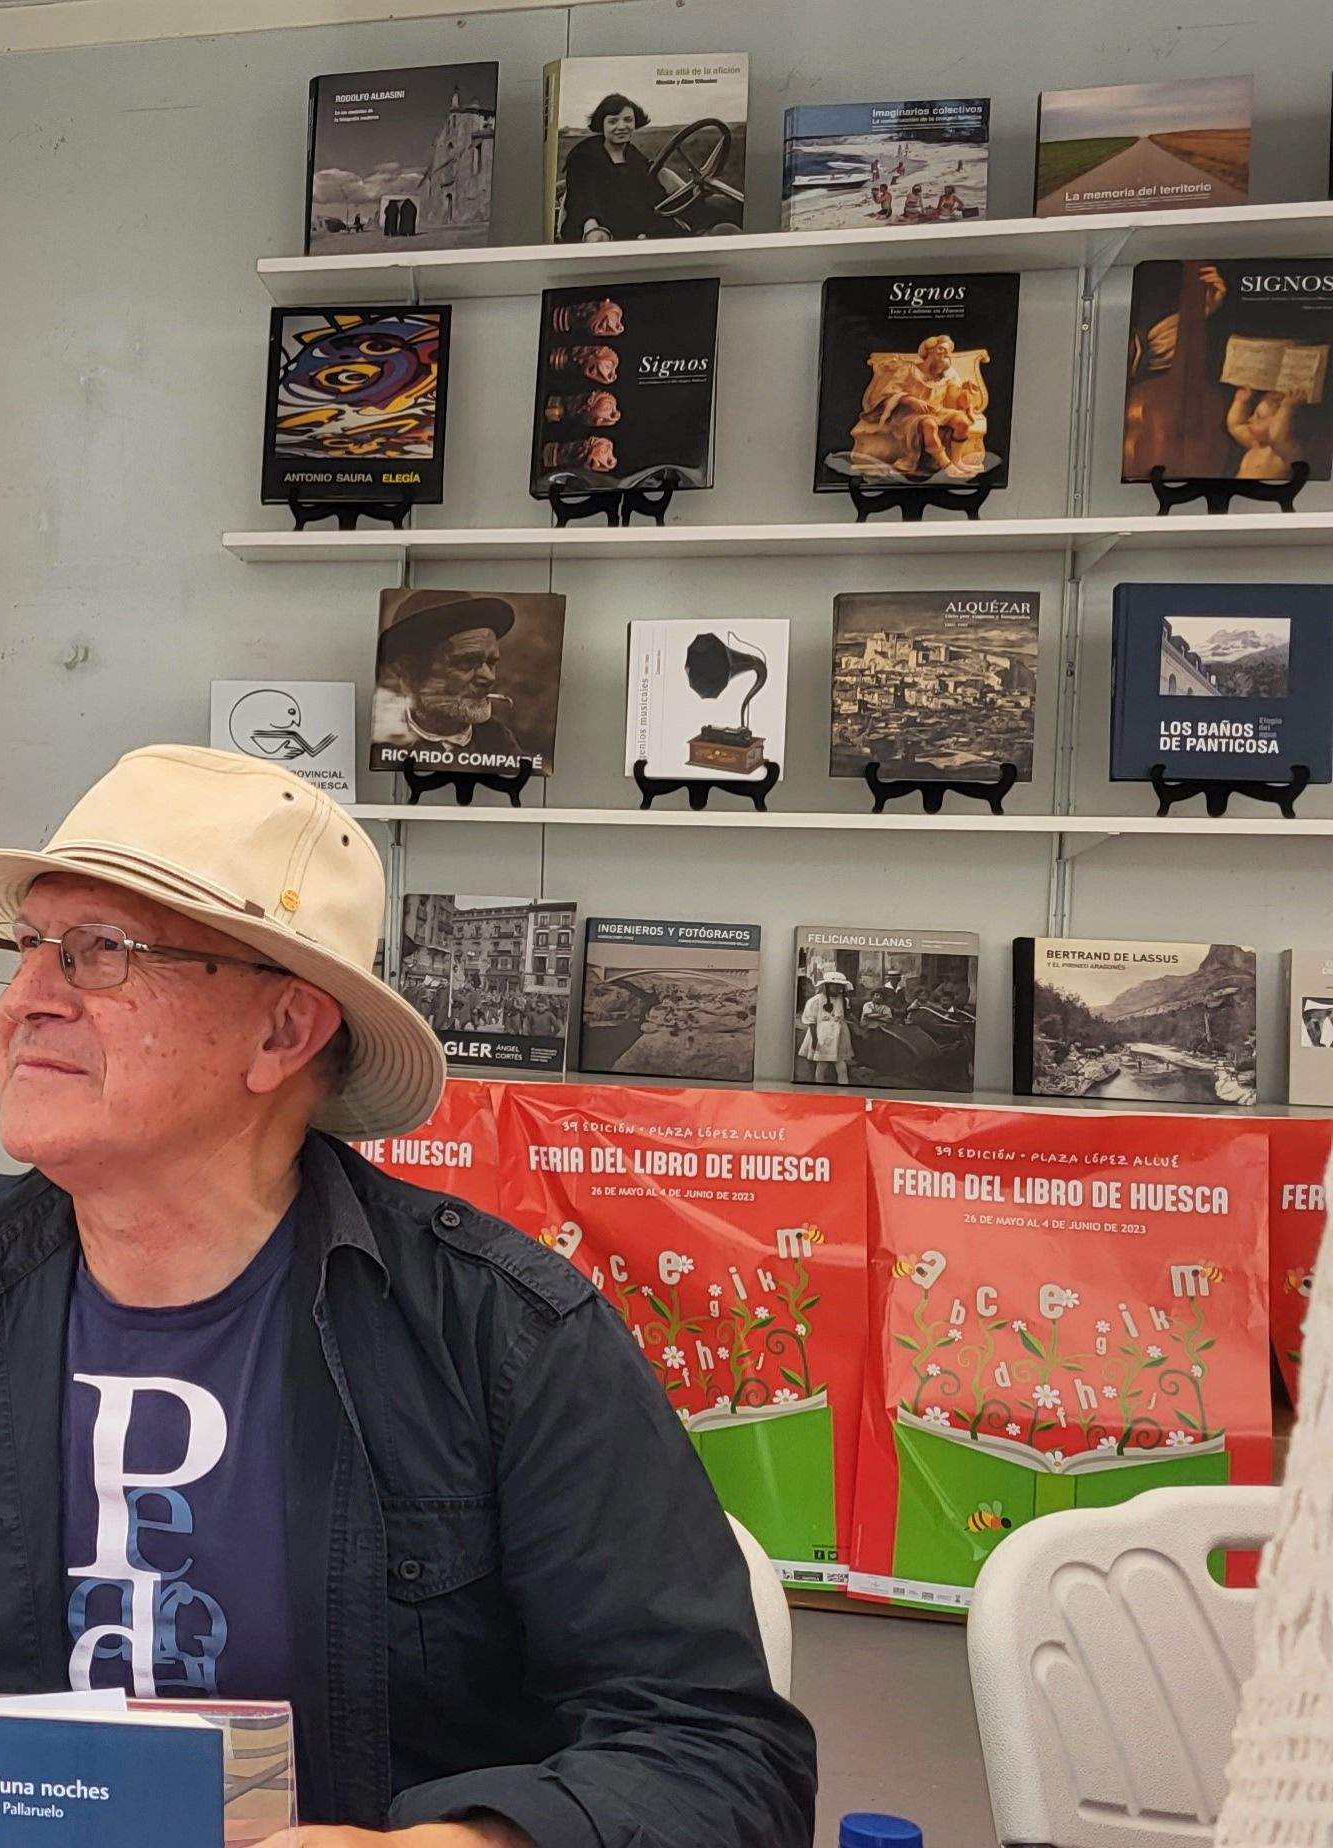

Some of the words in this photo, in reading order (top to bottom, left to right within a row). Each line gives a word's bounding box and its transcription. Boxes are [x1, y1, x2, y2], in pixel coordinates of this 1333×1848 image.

[335, 92, 369, 102] RODOLFO
[873, 107, 930, 119] Imaginarios
[933, 106, 983, 116] colectivos
[1066, 192, 1080, 201] La
[1083, 188, 1134, 200] memoria
[1138, 185, 1157, 197] del
[1160, 182, 1212, 194] territorio
[1241, 275, 1333, 293] SIGNOS
[889, 282, 966, 307] Signos
[639, 355, 709, 378] Signos
[284, 472, 333, 483] ANTONIO
[336, 472, 373, 483] SAURA
[382, 471, 421, 484] ELEGÍA
[945, 600, 1030, 614] ALQUÉZAR
[640, 678, 649, 726] musicales
[1160, 721, 1192, 736] LOS
[1198, 720, 1254, 738] BAÑOS
[1159, 737, 1181, 751] DE
[1186, 738, 1279, 754] PANTICOSA
[381, 749, 454, 764] RICARDO
[458, 752, 542, 769] COMPAIÉ
[598, 923, 664, 936] INGENIEROS
[668, 927, 676, 937] Y
[679, 926, 750, 940] FOTÓGRAFOS
[808, 933, 866, 946] FELICIANO
[869, 937, 913, 948] LLANAS
[1046, 950, 1111, 961] BERTRAND
[1114, 952, 1130, 962] DE
[1133, 953, 1179, 964] LASSUS
[443, 1040, 492, 1058] GLER
[495, 1052, 523, 1061] CORTÉS
[562, 1120, 579, 1132] 39
[582, 1121, 635, 1134] EDICIÓN
[649, 1125, 693, 1138] PLAZA
[698, 1126, 739, 1139] LÓPEZ
[743, 1128, 786, 1141] ALLUÉ
[360, 1138, 385, 1164] DE
[391, 1138, 472, 1168] HUESCA
[935, 1146, 952, 1157] 39
[958, 1148, 1015, 1161] EDICIÓN
[1031, 1152, 1078, 1164] PLAZA
[1085, 1153, 1128, 1165] LÓPEZ
[1133, 1154, 1180, 1168] ALLUÉ
[529, 1145, 584, 1173] FERIA
[591, 1147, 627, 1174] DEL
[634, 1149, 698, 1177] LIBRO
[706, 1153, 733, 1179] DE
[740, 1154, 830, 1182] HUESCA
[591, 1186, 602, 1196] 26
[605, 1186, 616, 1196] DE
[619, 1187, 644, 1197] MAYO
[646, 1188, 658, 1197] AL
[669, 1189, 681, 1198] DE
[684, 1189, 713, 1199] JUNIO
[716, 1191, 729, 1200] DE
[732, 1192, 755, 1202] 2023
[893, 1167, 956, 1199] FERIA
[964, 1174, 1005, 1202] DEL
[1013, 1176, 1083, 1207] LIBRO
[1092, 1181, 1122, 1210] DE
[1131, 1183, 1229, 1215] HUESCA
[964, 1213, 976, 1223] 26
[980, 1215, 993, 1225] DE
[996, 1217, 1024, 1226] MAYO
[1027, 1218, 1039, 1227] AL
[1051, 1220, 1065, 1230] DE
[1068, 1221, 1100, 1231] JUNIO
[1104, 1223, 1118, 1233] DE
[1121, 1224, 1146, 1234] 2023
[41, 1779, 110, 1801] noches
[3, 1801, 64, 1818] Pallaruelo
